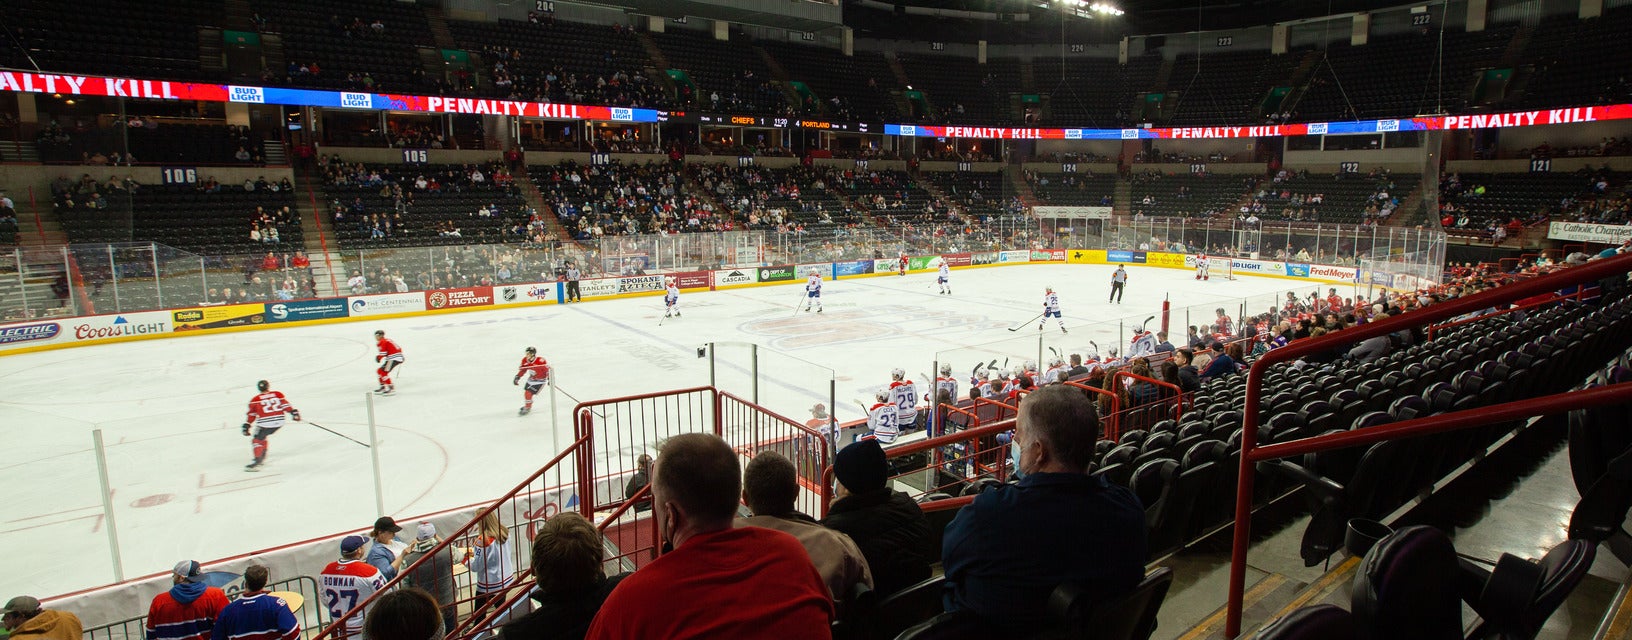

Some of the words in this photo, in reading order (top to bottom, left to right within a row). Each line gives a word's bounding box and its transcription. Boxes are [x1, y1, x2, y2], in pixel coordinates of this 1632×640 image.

[536, 1, 554, 12] 204
[1414, 15, 1430, 25] 222
[803, 32, 814, 41] 202
[932, 42, 944, 50] 201
[1071, 44, 1084, 52] 224
[105, 78, 178, 99] KILL
[234, 87, 257, 95] BUD
[231, 93, 261, 102] LIGHT
[346, 93, 366, 101] BUD
[343, 99, 371, 107] LIGHT
[427, 96, 528, 116] PENALTY
[538, 102, 581, 119] KILL
[731, 116, 755, 125] CHIEFS
[1443, 111, 1541, 130] PENALTY
[1548, 106, 1597, 124] KILL
[802, 120, 830, 129] PORTLAND
[945, 127, 1004, 139] PENALTY
[1012, 128, 1042, 139] KILL
[1171, 126, 1242, 139] PENALTY
[1249, 126, 1282, 137] KILL
[404, 150, 427, 163] 105
[592, 153, 610, 165] 104
[959, 162, 971, 172] 101
[1062, 163, 1077, 173] 124
[1532, 159, 1550, 171] 121
[165, 168, 196, 184] 106
[1563, 223, 1594, 233] Catholic
[1595, 225, 1632, 237] Charities
[1310, 267, 1329, 276] Fred
[1329, 269, 1355, 279] Meyer
[620, 276, 661, 284] SPOKANE
[721, 275, 751, 283] CASCADIA
[618, 282, 663, 293] AZTECA
[448, 291, 475, 299] PIZZA
[380, 298, 423, 306] CENTENNIAL
[448, 296, 489, 306] FACTORY
[74, 321, 122, 340] Coors
[124, 322, 165, 336] LIGHT
[261, 397, 283, 413] 22
[897, 392, 915, 410] 29
[324, 576, 355, 586] BOWMAN
[325, 588, 359, 618] 27
